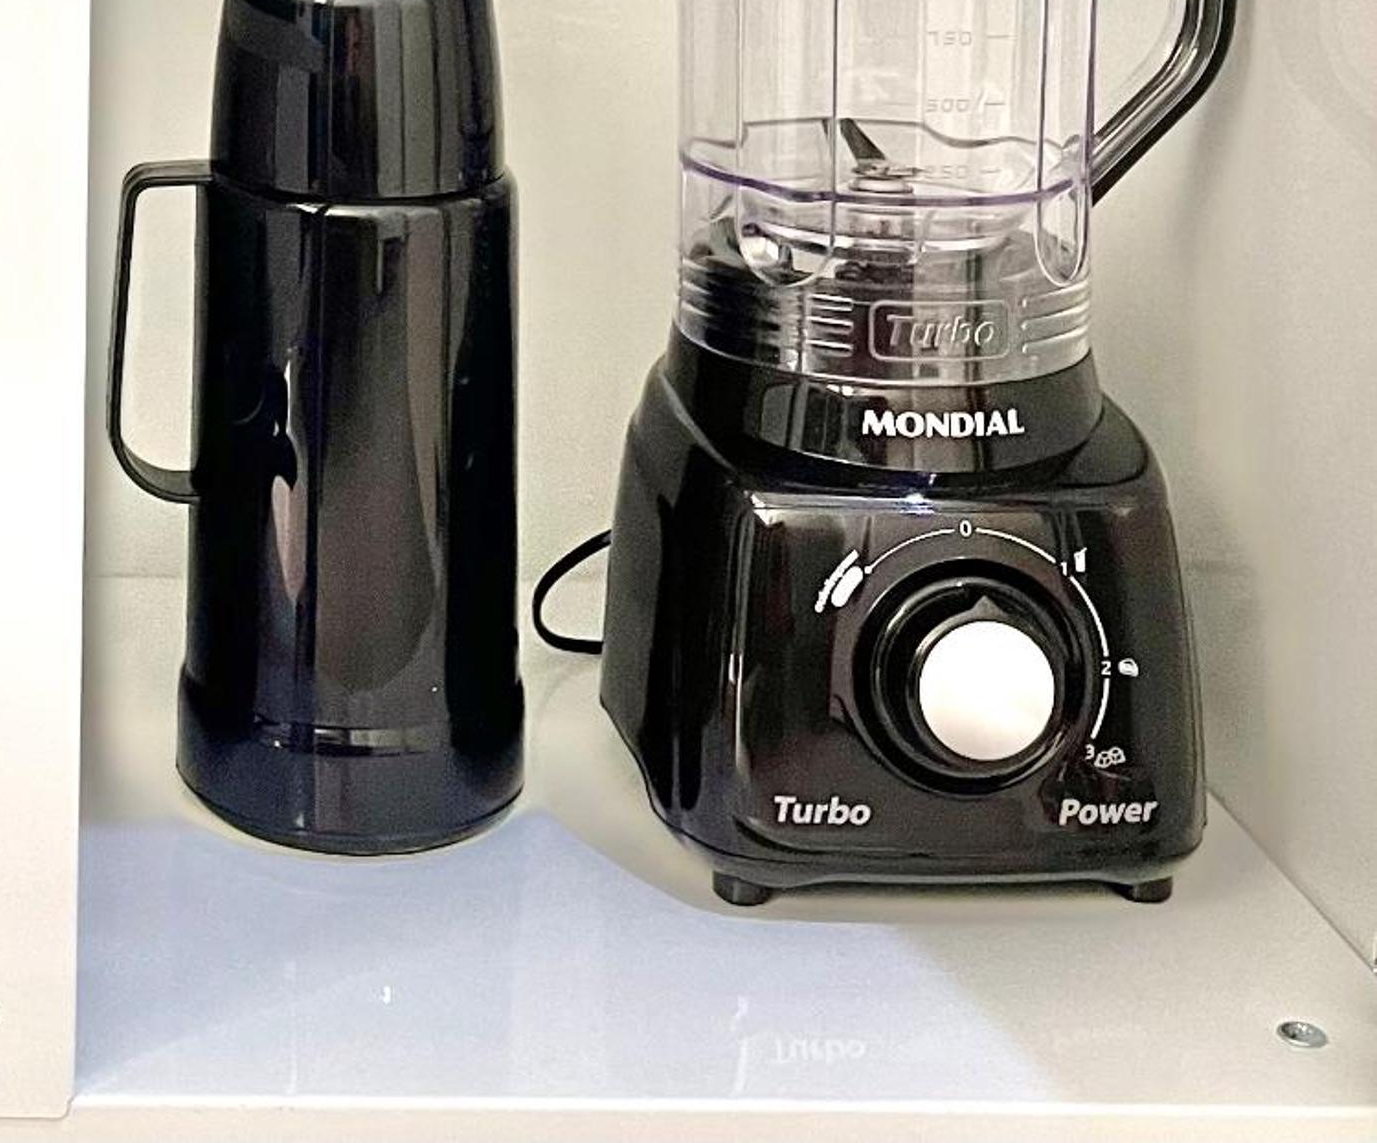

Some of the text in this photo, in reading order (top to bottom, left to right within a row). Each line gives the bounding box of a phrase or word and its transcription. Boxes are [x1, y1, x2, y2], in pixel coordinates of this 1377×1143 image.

[886, 313, 995, 348] Turbo
[861, 408, 1025, 439] MONDIAL
[958, 520, 973, 537] 0
[1100, 660, 1112, 676] 2
[1084, 743, 1096, 760] 3
[773, 795, 1159, 826] Turbo Power
